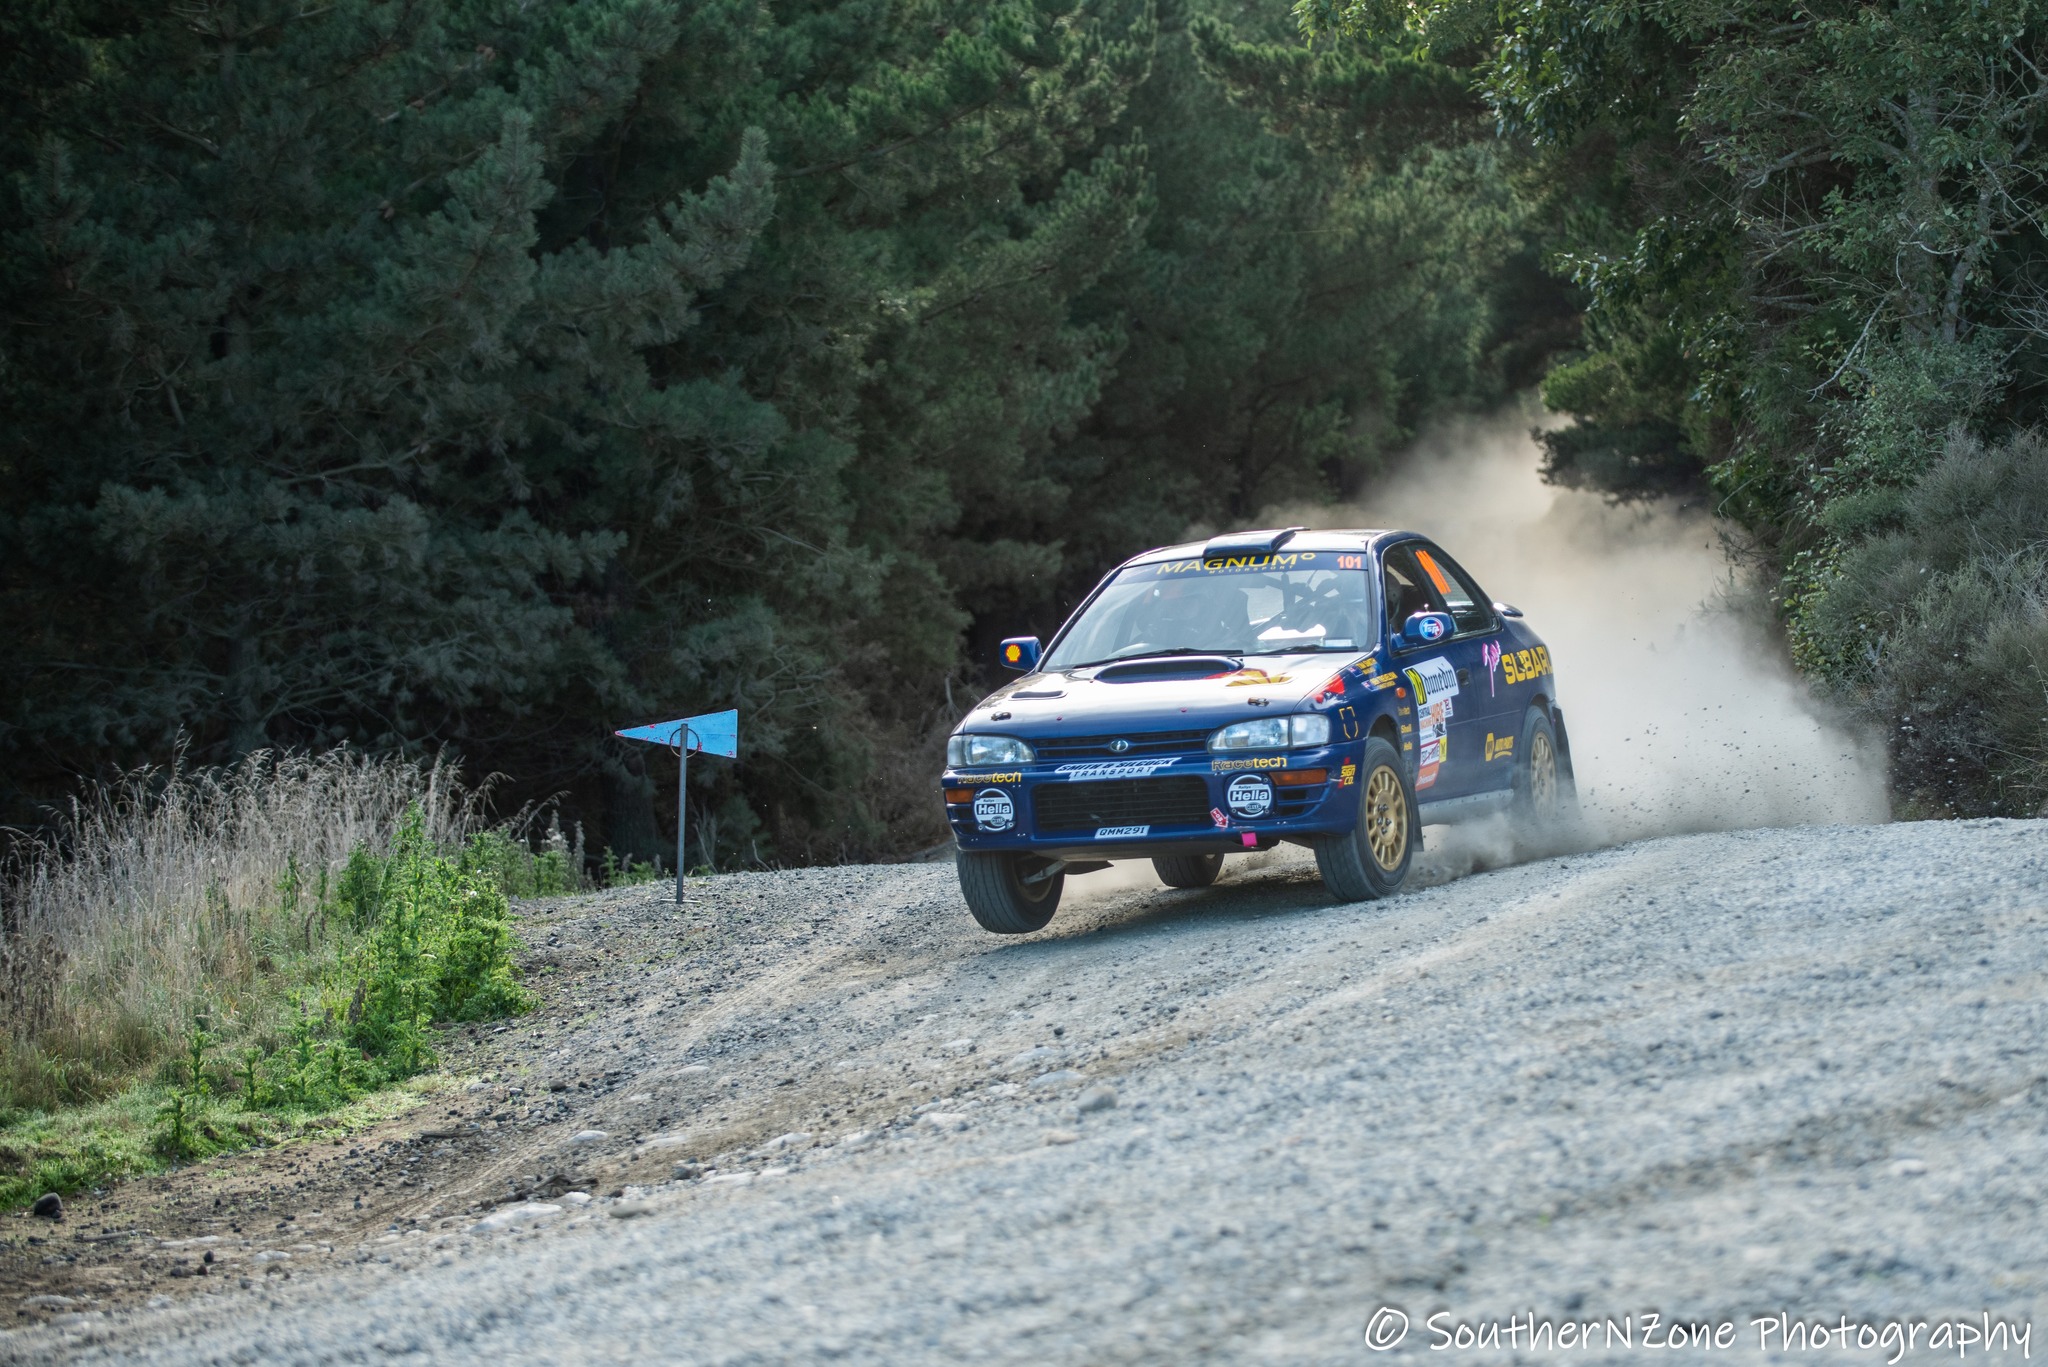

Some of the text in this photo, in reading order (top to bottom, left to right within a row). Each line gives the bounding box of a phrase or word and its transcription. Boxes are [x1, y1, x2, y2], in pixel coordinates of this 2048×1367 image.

[1337, 554, 1362, 570] 101
[1208, 564, 1294, 575] MOTORSPORT
[1060, 764, 1097, 772] SMITH
[1212, 756, 1287, 771] Racetech
[1073, 766, 1154, 778] TRANSPORT
[1232, 790, 1268, 801] Hella
[978, 803, 1010, 815] Hella
[1099, 826, 1146, 836] QMM291
